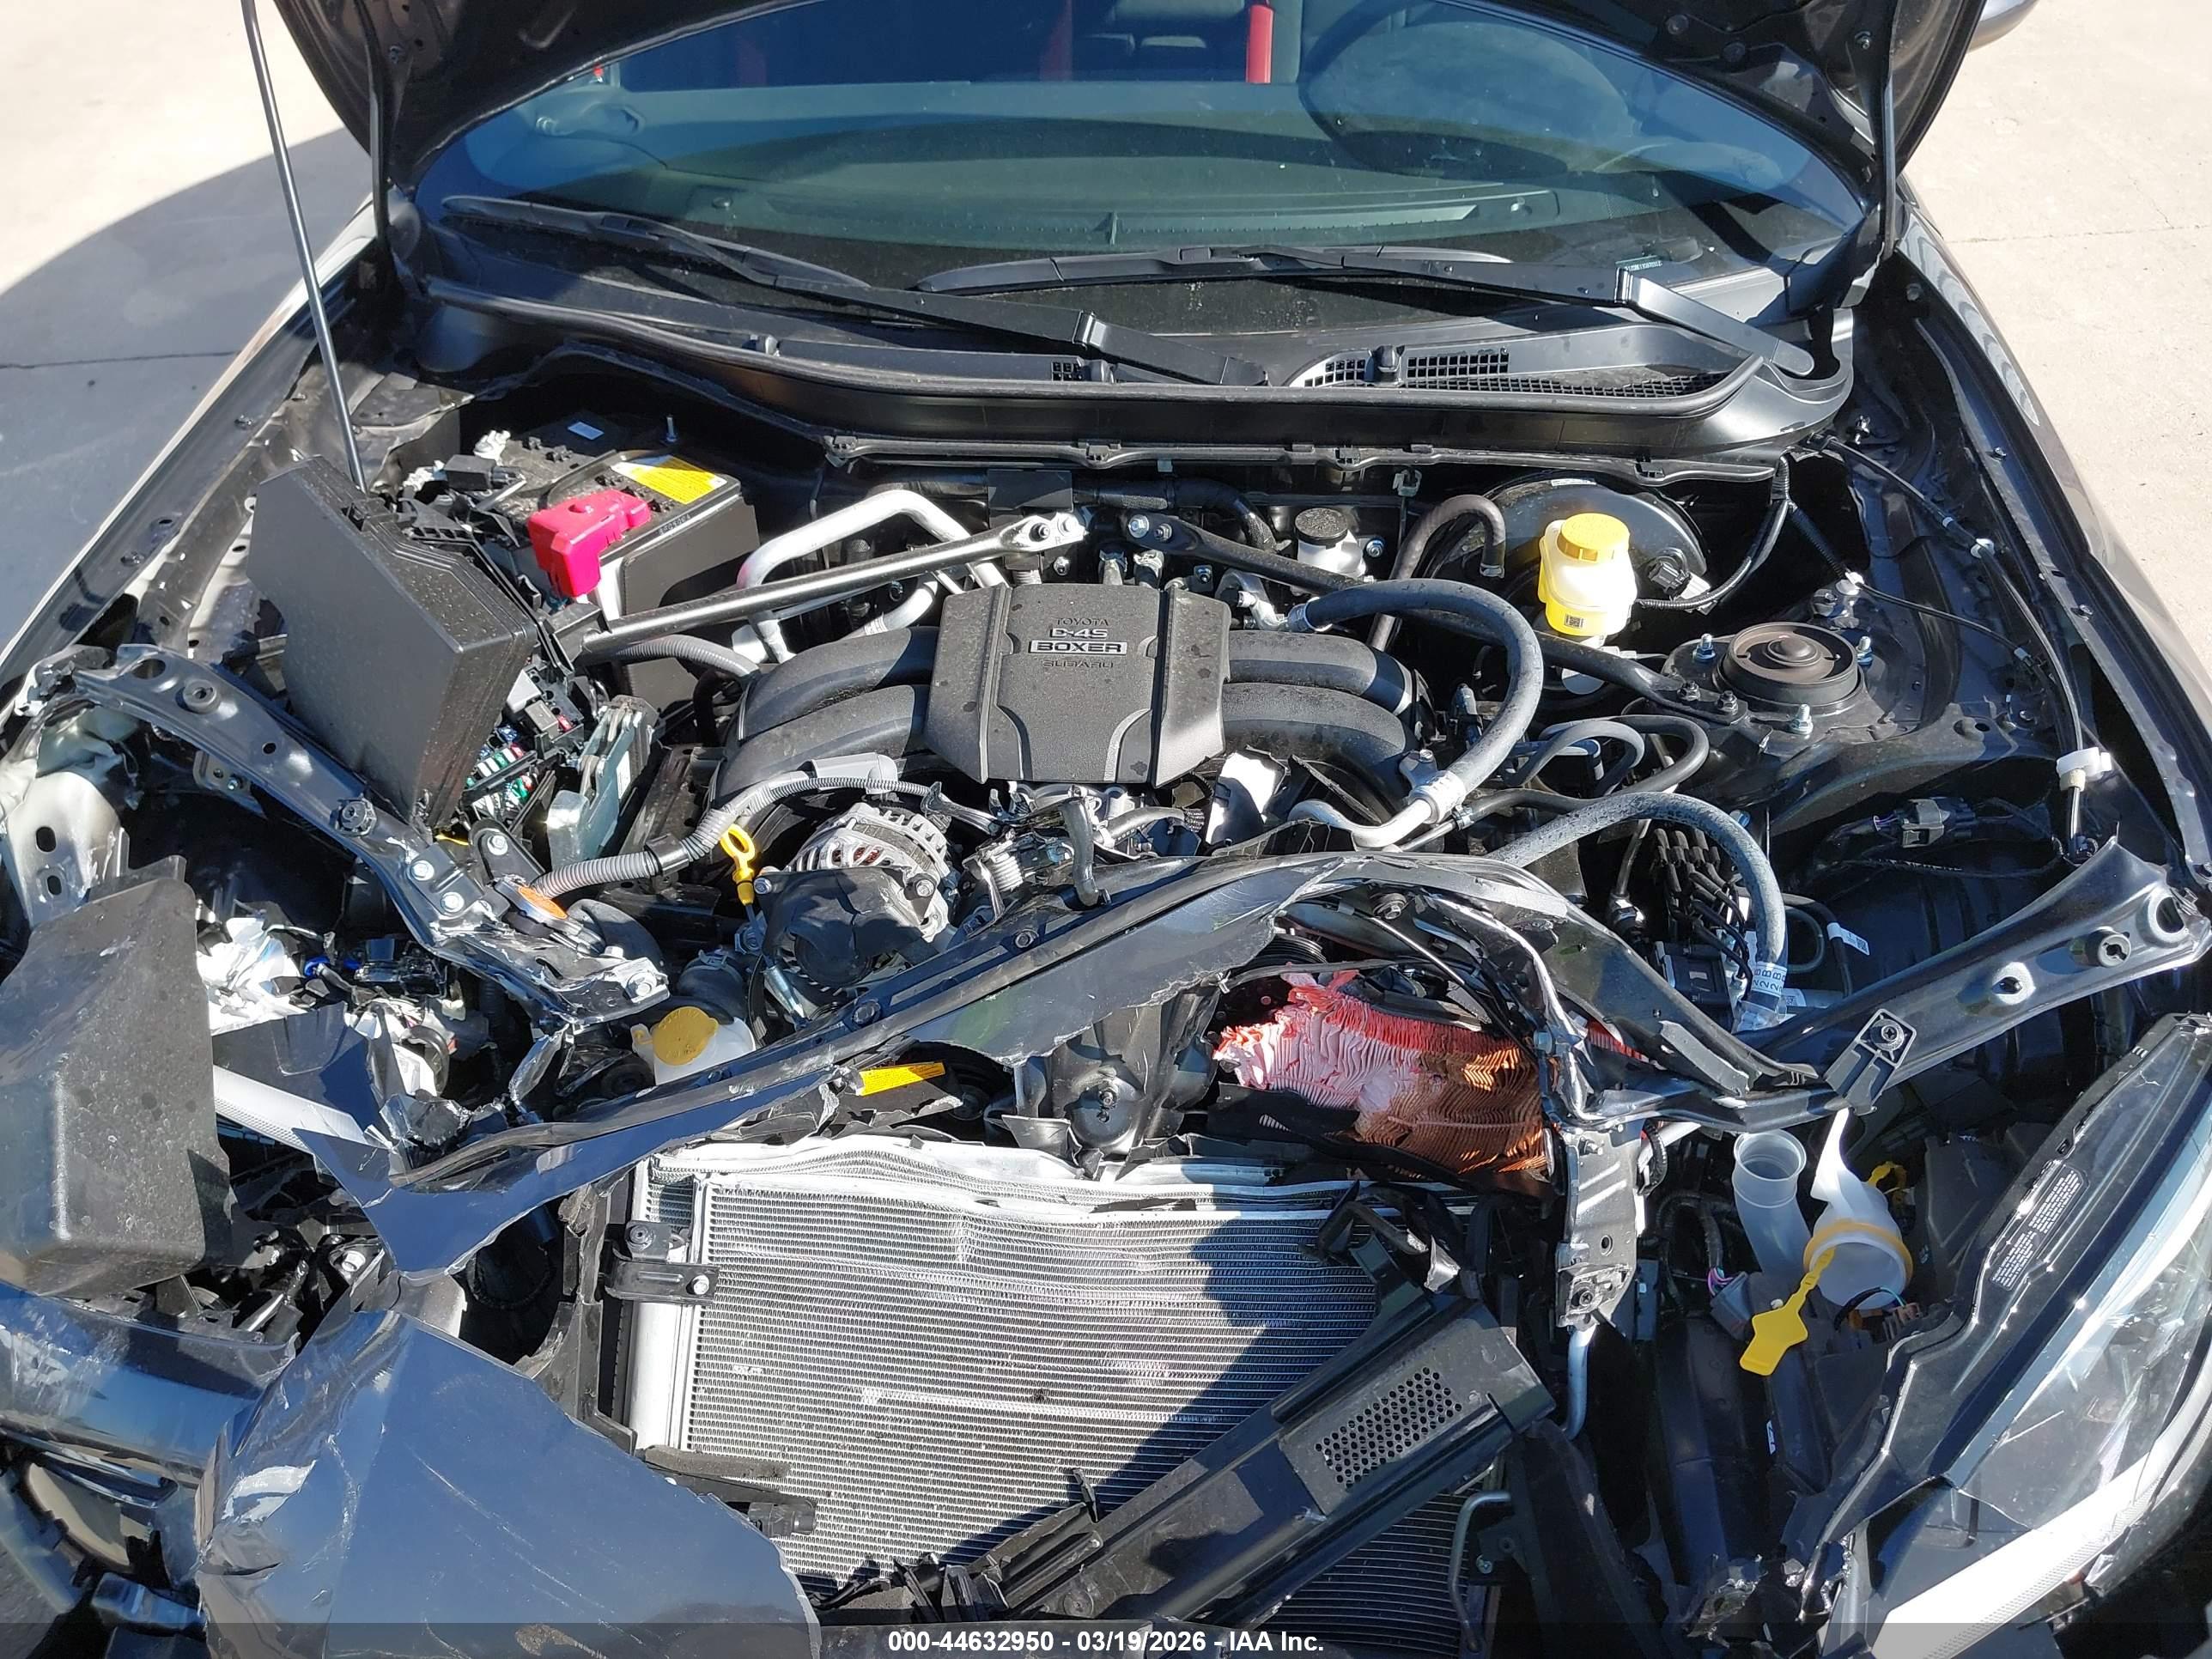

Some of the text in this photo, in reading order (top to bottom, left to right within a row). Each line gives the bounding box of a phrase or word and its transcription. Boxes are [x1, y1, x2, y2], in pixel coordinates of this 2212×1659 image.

[1057, 617, 1109, 626] TOYOTA
[1049, 628, 1108, 639] D-4S
[1036, 642, 1121, 653] BOXER
[1042, 659, 1113, 668] SUBARU
